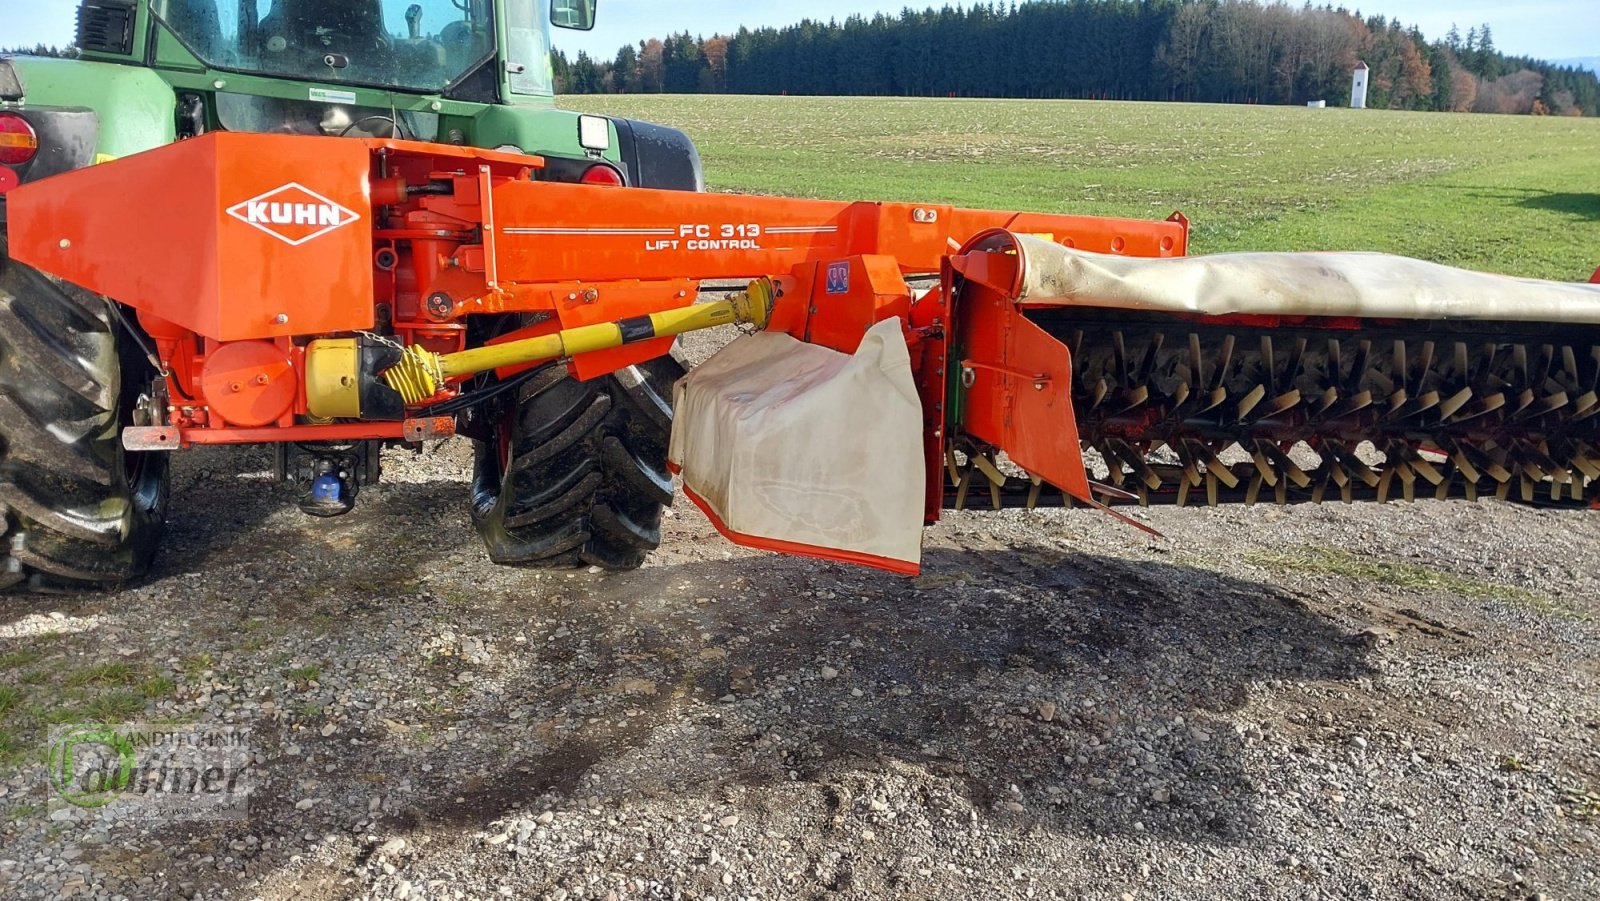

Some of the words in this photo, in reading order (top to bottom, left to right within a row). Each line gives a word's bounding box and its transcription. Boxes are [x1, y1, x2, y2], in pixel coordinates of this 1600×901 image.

[247, 201, 340, 226] KUHN
[680, 224, 710, 238] FC
[720, 224, 760, 237] 313
[645, 240, 679, 250] LIFT
[687, 239, 760, 250] CONTROL
